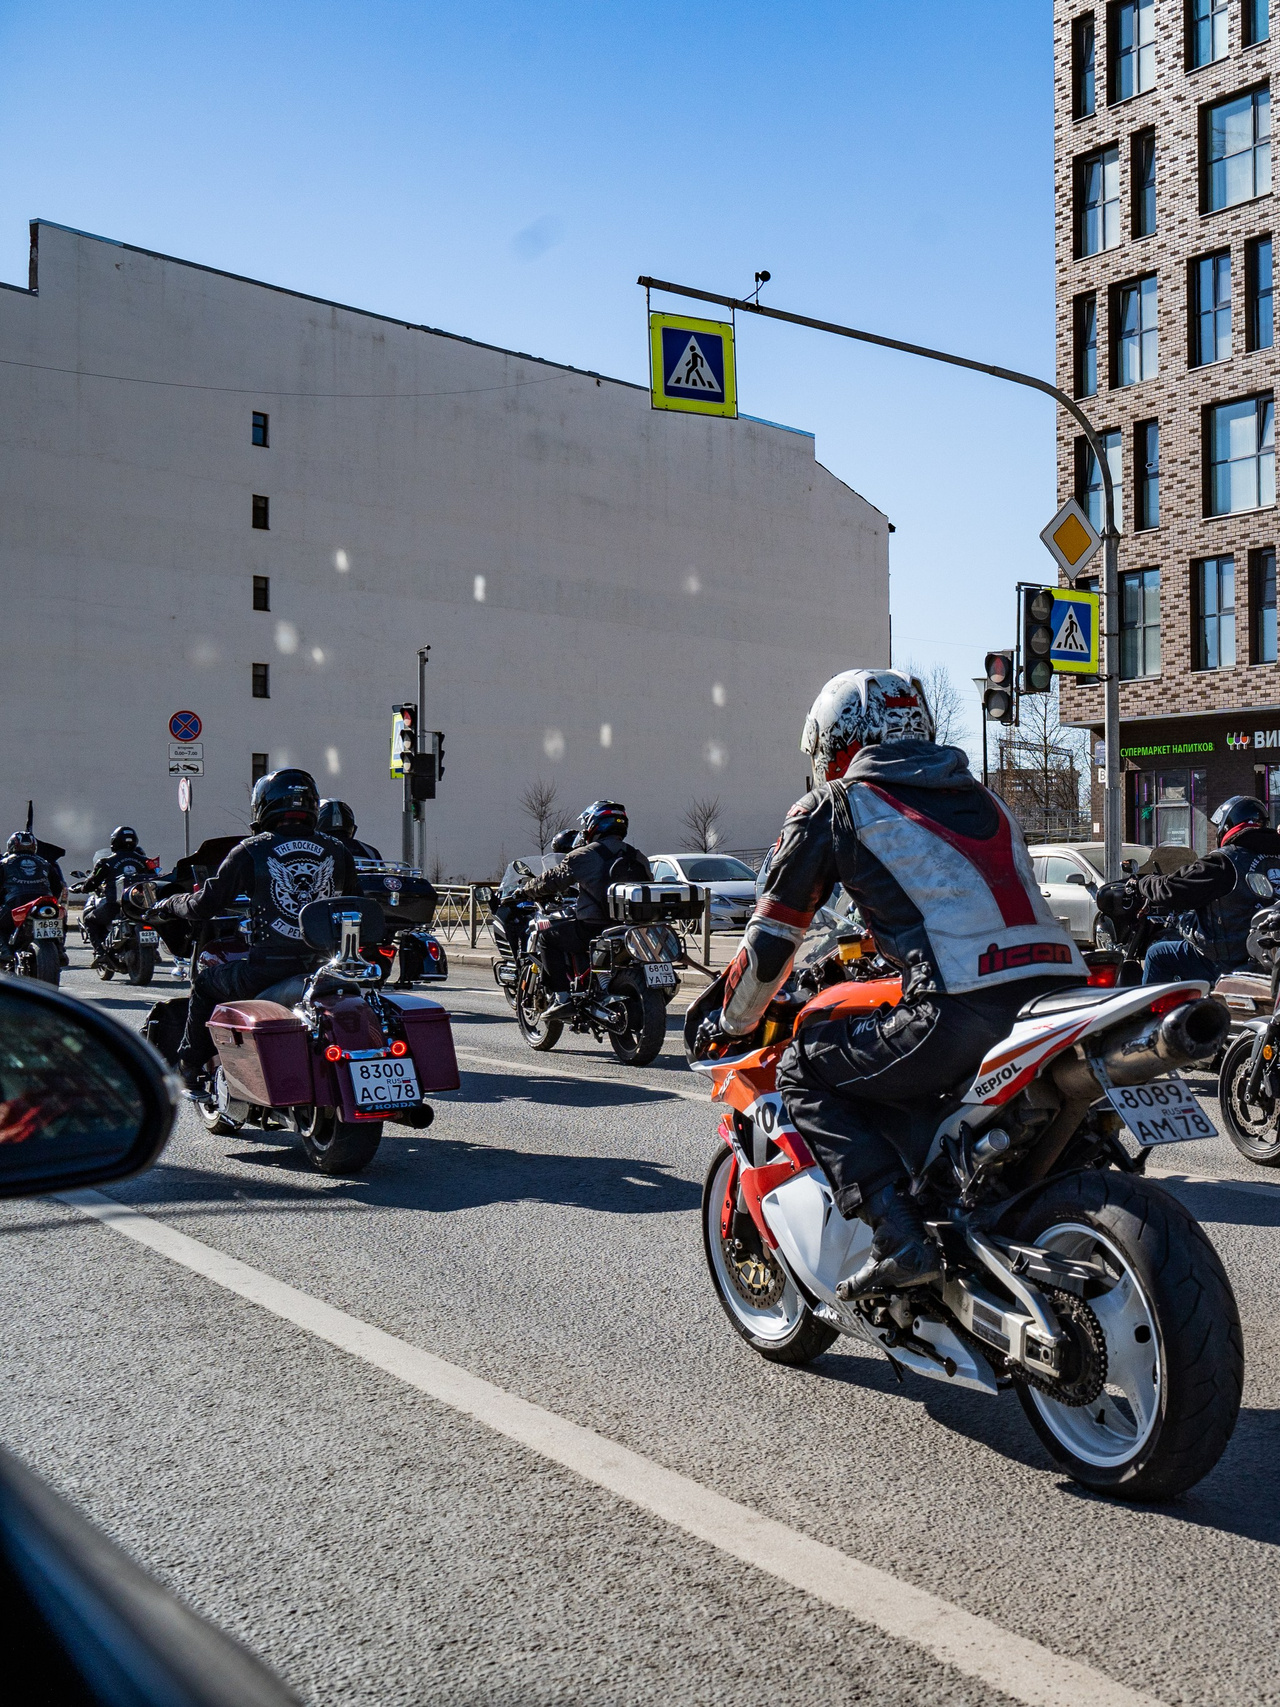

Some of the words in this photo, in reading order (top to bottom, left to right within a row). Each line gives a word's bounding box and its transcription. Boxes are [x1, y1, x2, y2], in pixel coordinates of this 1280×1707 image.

[1120, 744, 1171, 757] СУПЕРМАРКЕТ
[1172, 742, 1214, 754] НАПИТКОВ
[276, 844, 291, 854] THE
[292, 841, 323, 854] ROCKERS
[38, 921, 59, 929] 1689
[51, 929, 62, 937] 92
[648, 964, 669, 973] 6810
[662, 974, 674, 984] 73
[359, 1062, 405, 1080] 8300
[974, 1062, 1023, 1098] REPSOL
[392, 1084, 416, 1100] 78
[1122, 1084, 1182, 1109] 8089
[374, 1101, 417, 1110] HONDA
[1162, 1107, 1182, 1117] RUS
[1175, 1115, 1210, 1139] 78
